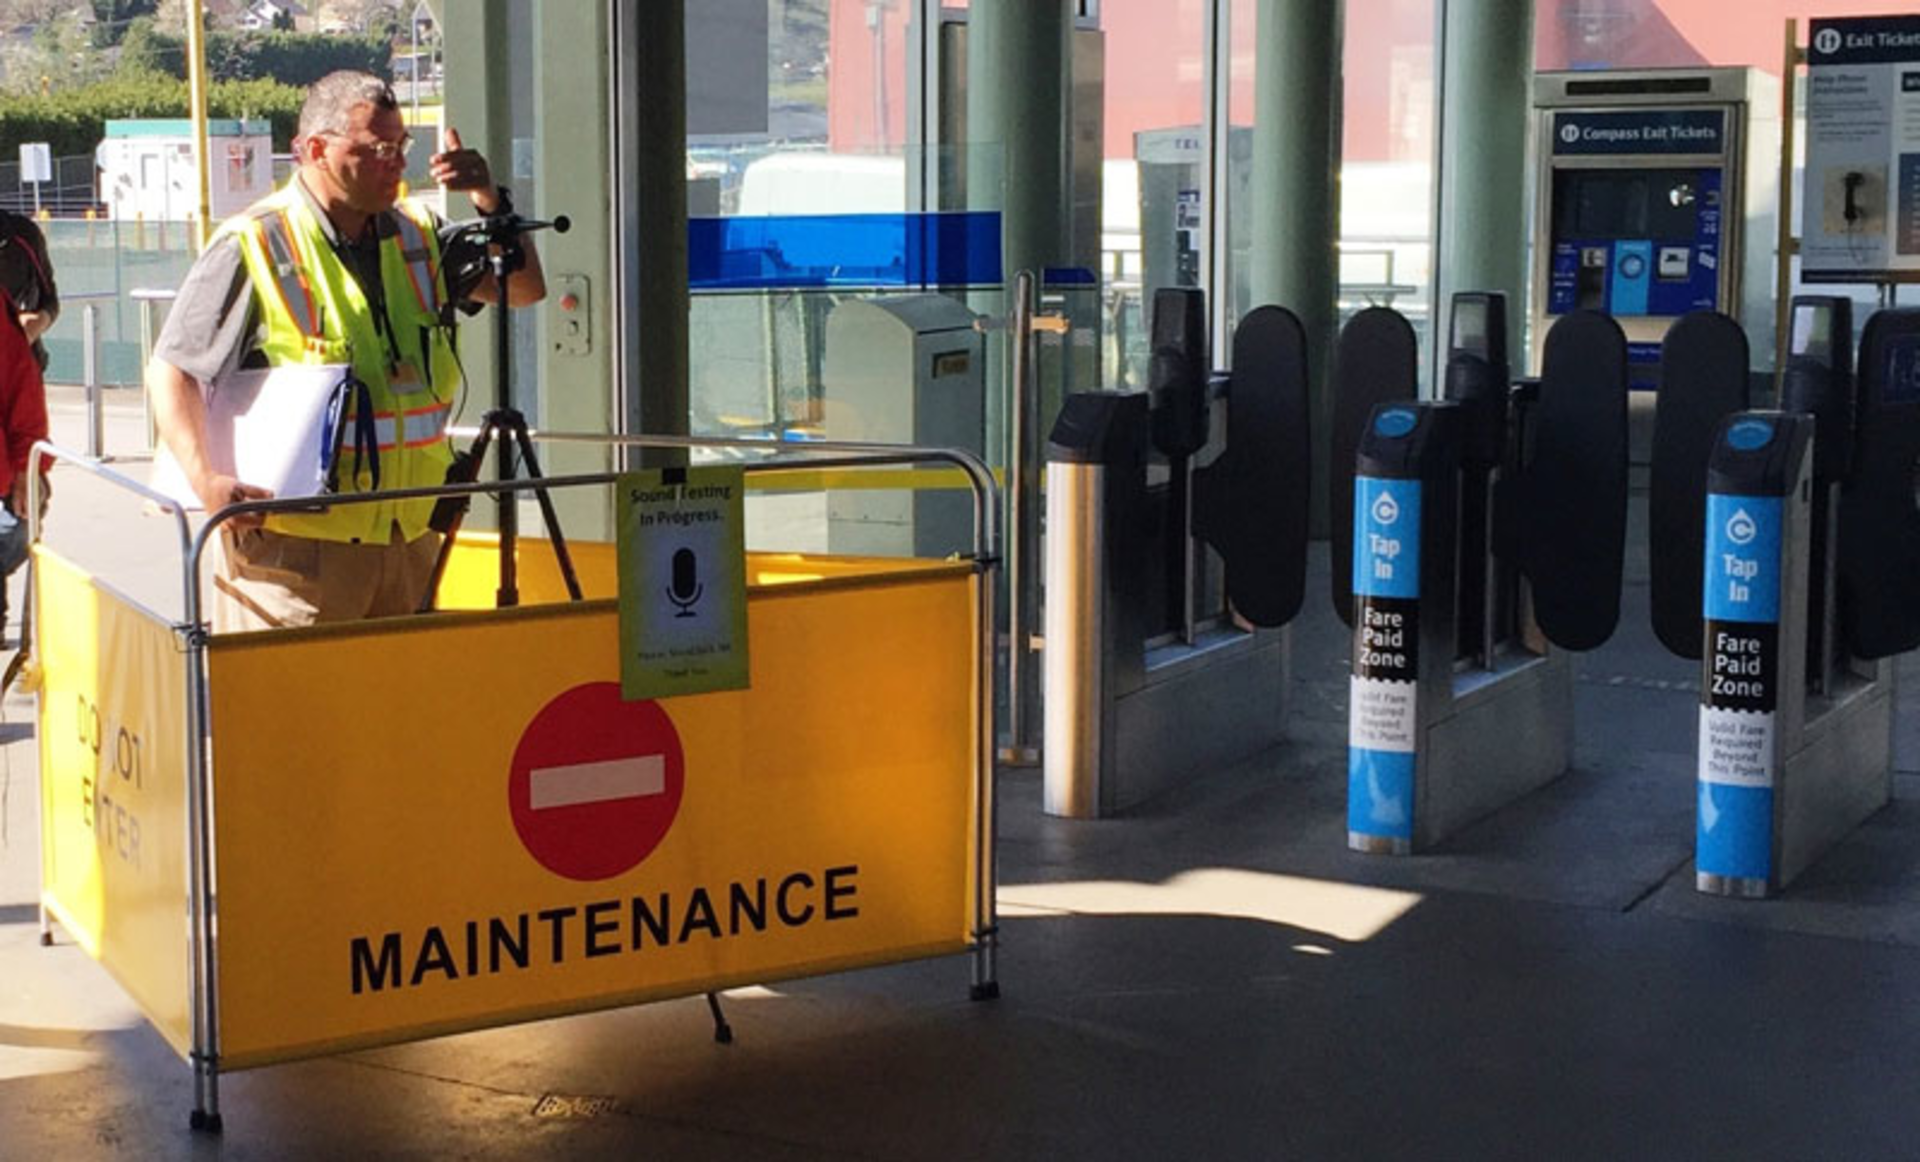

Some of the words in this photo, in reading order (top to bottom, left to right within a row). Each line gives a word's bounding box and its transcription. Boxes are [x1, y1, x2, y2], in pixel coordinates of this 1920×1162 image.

[1845, 32, 1874, 48] Exit
[1583, 127, 1640, 142] Compass
[1643, 127, 1667, 139] Exit
[1671, 125, 1717, 139] Tickets
[631, 487, 676, 503] Sound
[681, 485, 731, 500] Testing
[640, 513, 654, 526] In
[1369, 534, 1400, 558] Tap
[1374, 559, 1393, 579] In
[1722, 554, 1758, 581] Tap
[1729, 580, 1749, 601] In
[1365, 607, 1403, 627] Fare
[1363, 627, 1403, 647] Paid
[1716, 633, 1761, 654] Fare
[1360, 648, 1406, 668] Zone
[1715, 654, 1761, 676] Paid
[1712, 675, 1764, 697] Zone
[350, 865, 859, 994] MAINTENANCE
